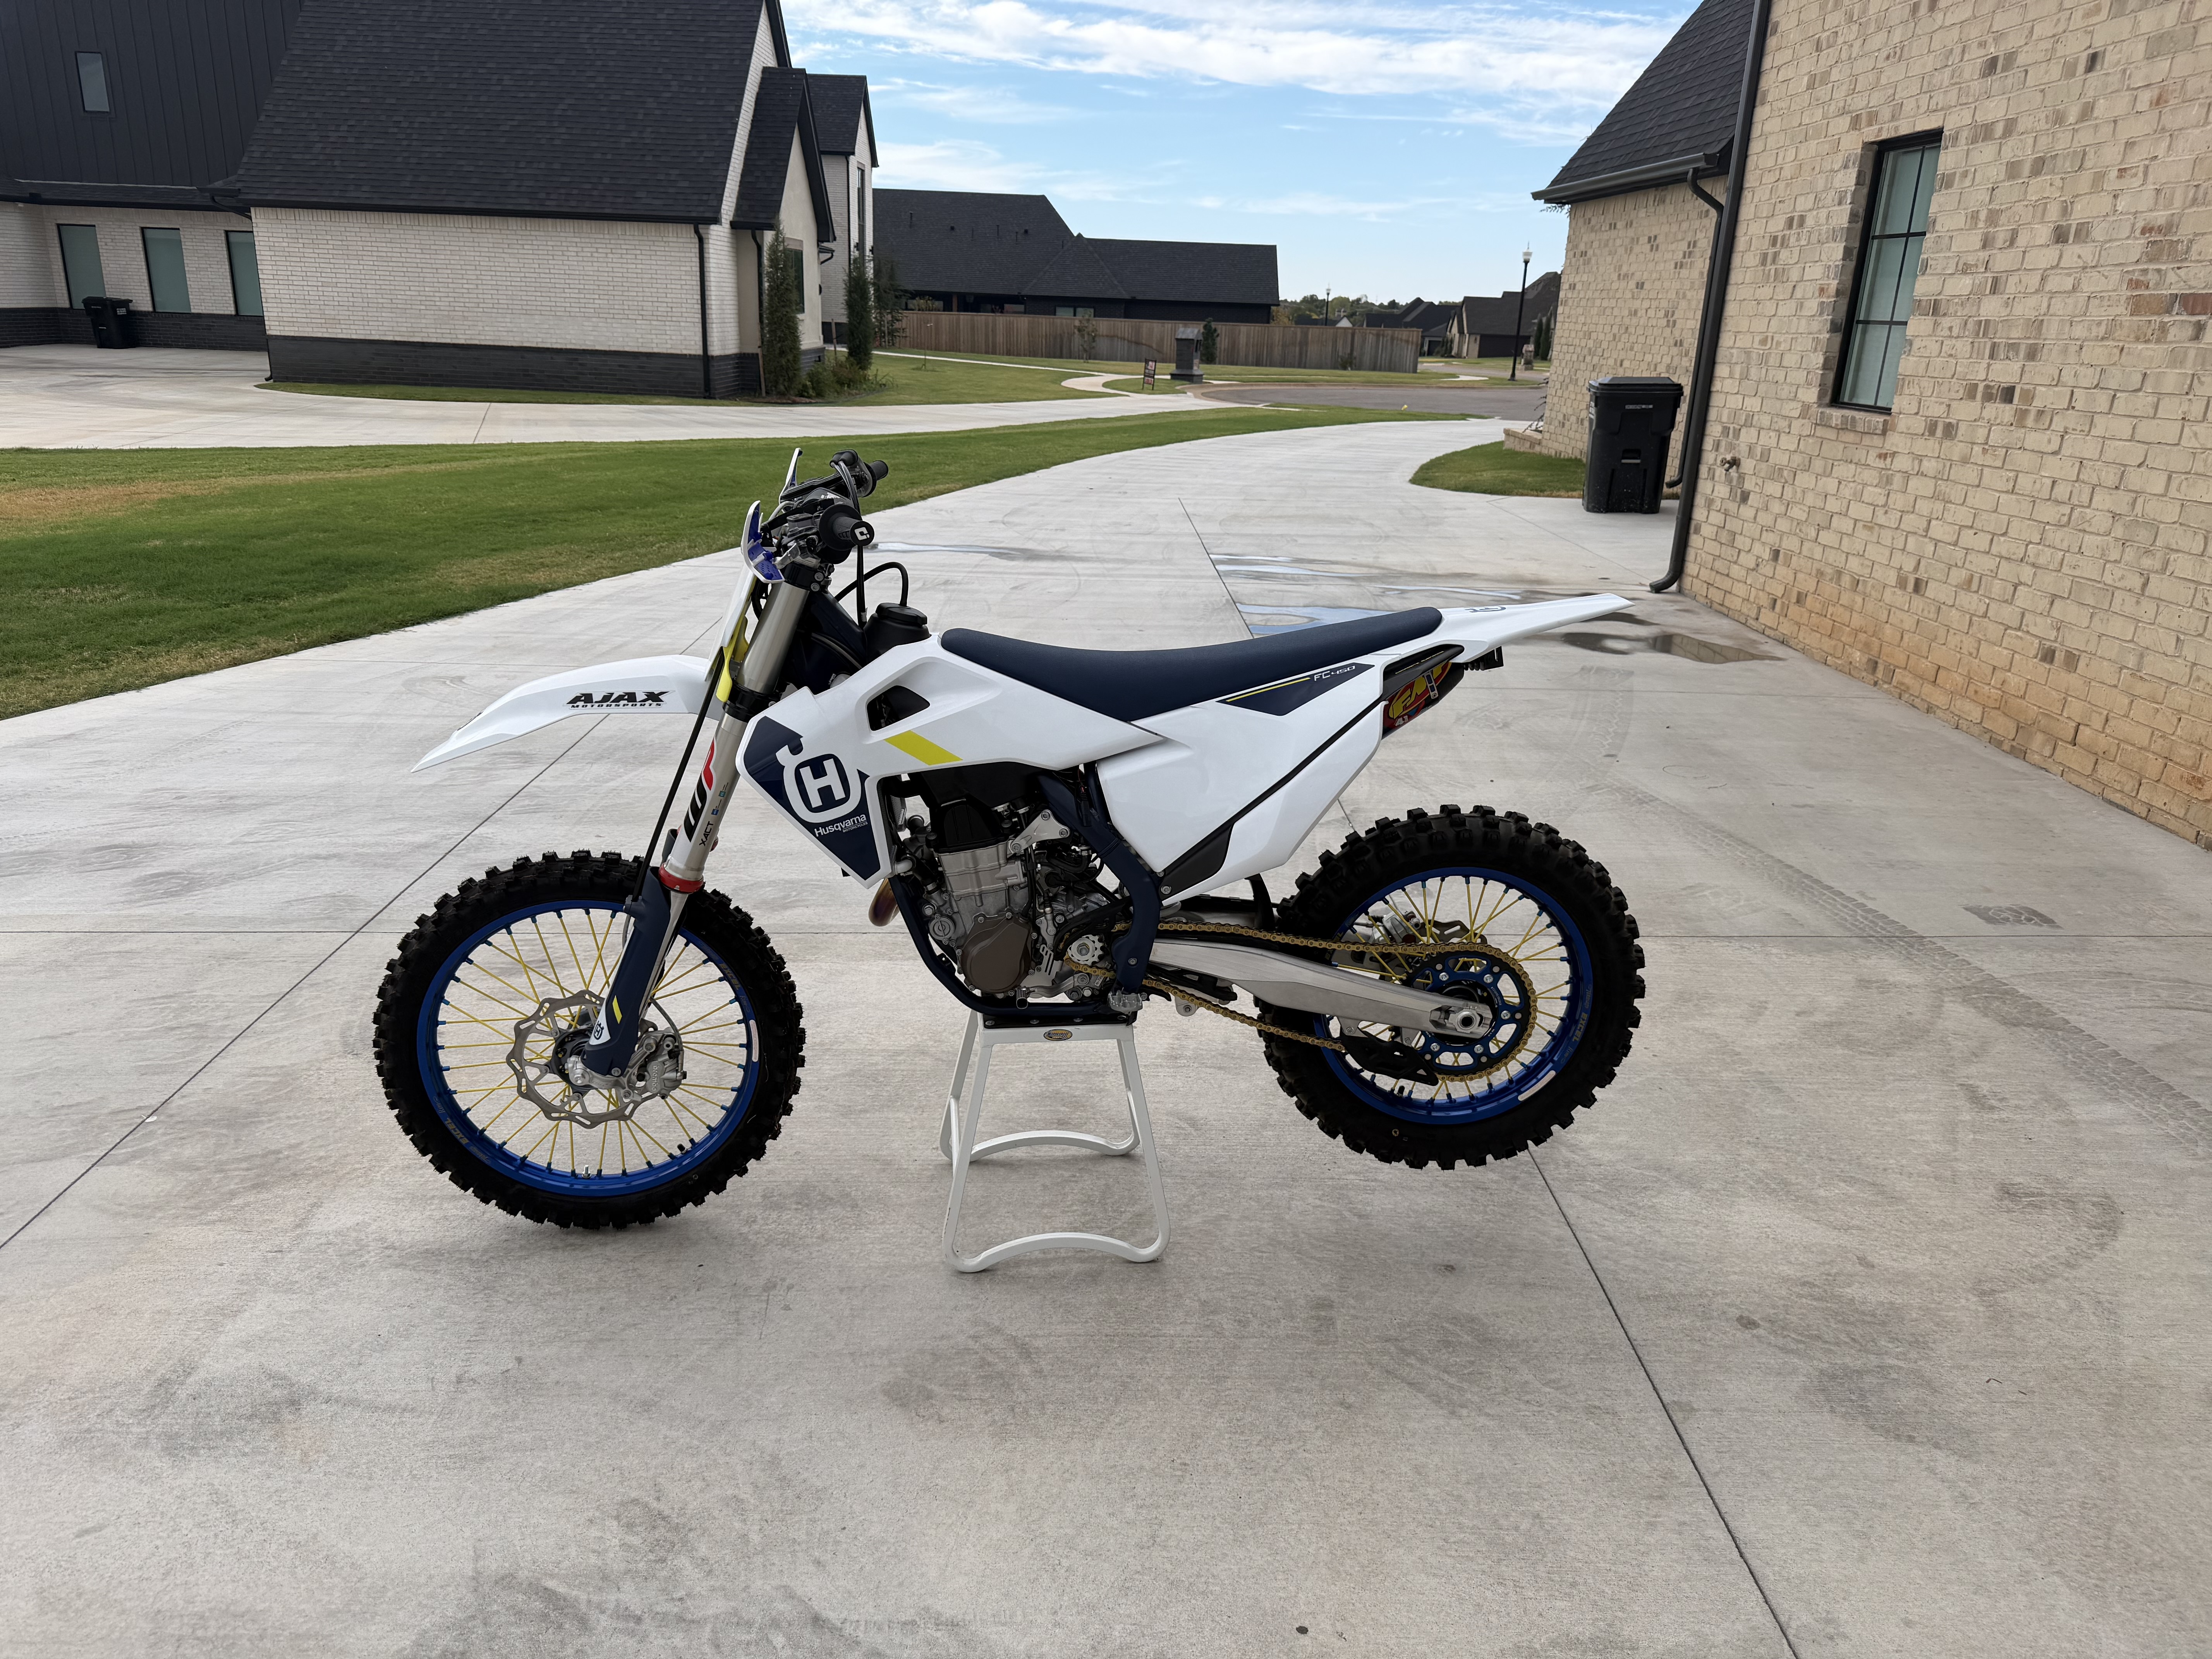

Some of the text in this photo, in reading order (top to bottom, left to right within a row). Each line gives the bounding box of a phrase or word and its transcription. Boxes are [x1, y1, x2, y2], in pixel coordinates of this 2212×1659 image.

[1314, 671, 1331, 681] FC
[566, 691, 670, 704] AJAX
[699, 821, 713, 846] XACT
[814, 814, 867, 837] Husqvarna
[843, 821, 868, 833] MOTORCYCLES
[719, 963, 741, 991] EXCEL
[1572, 1012, 1588, 1042] EXCEL
[445, 1117, 470, 1144] EXCEL
